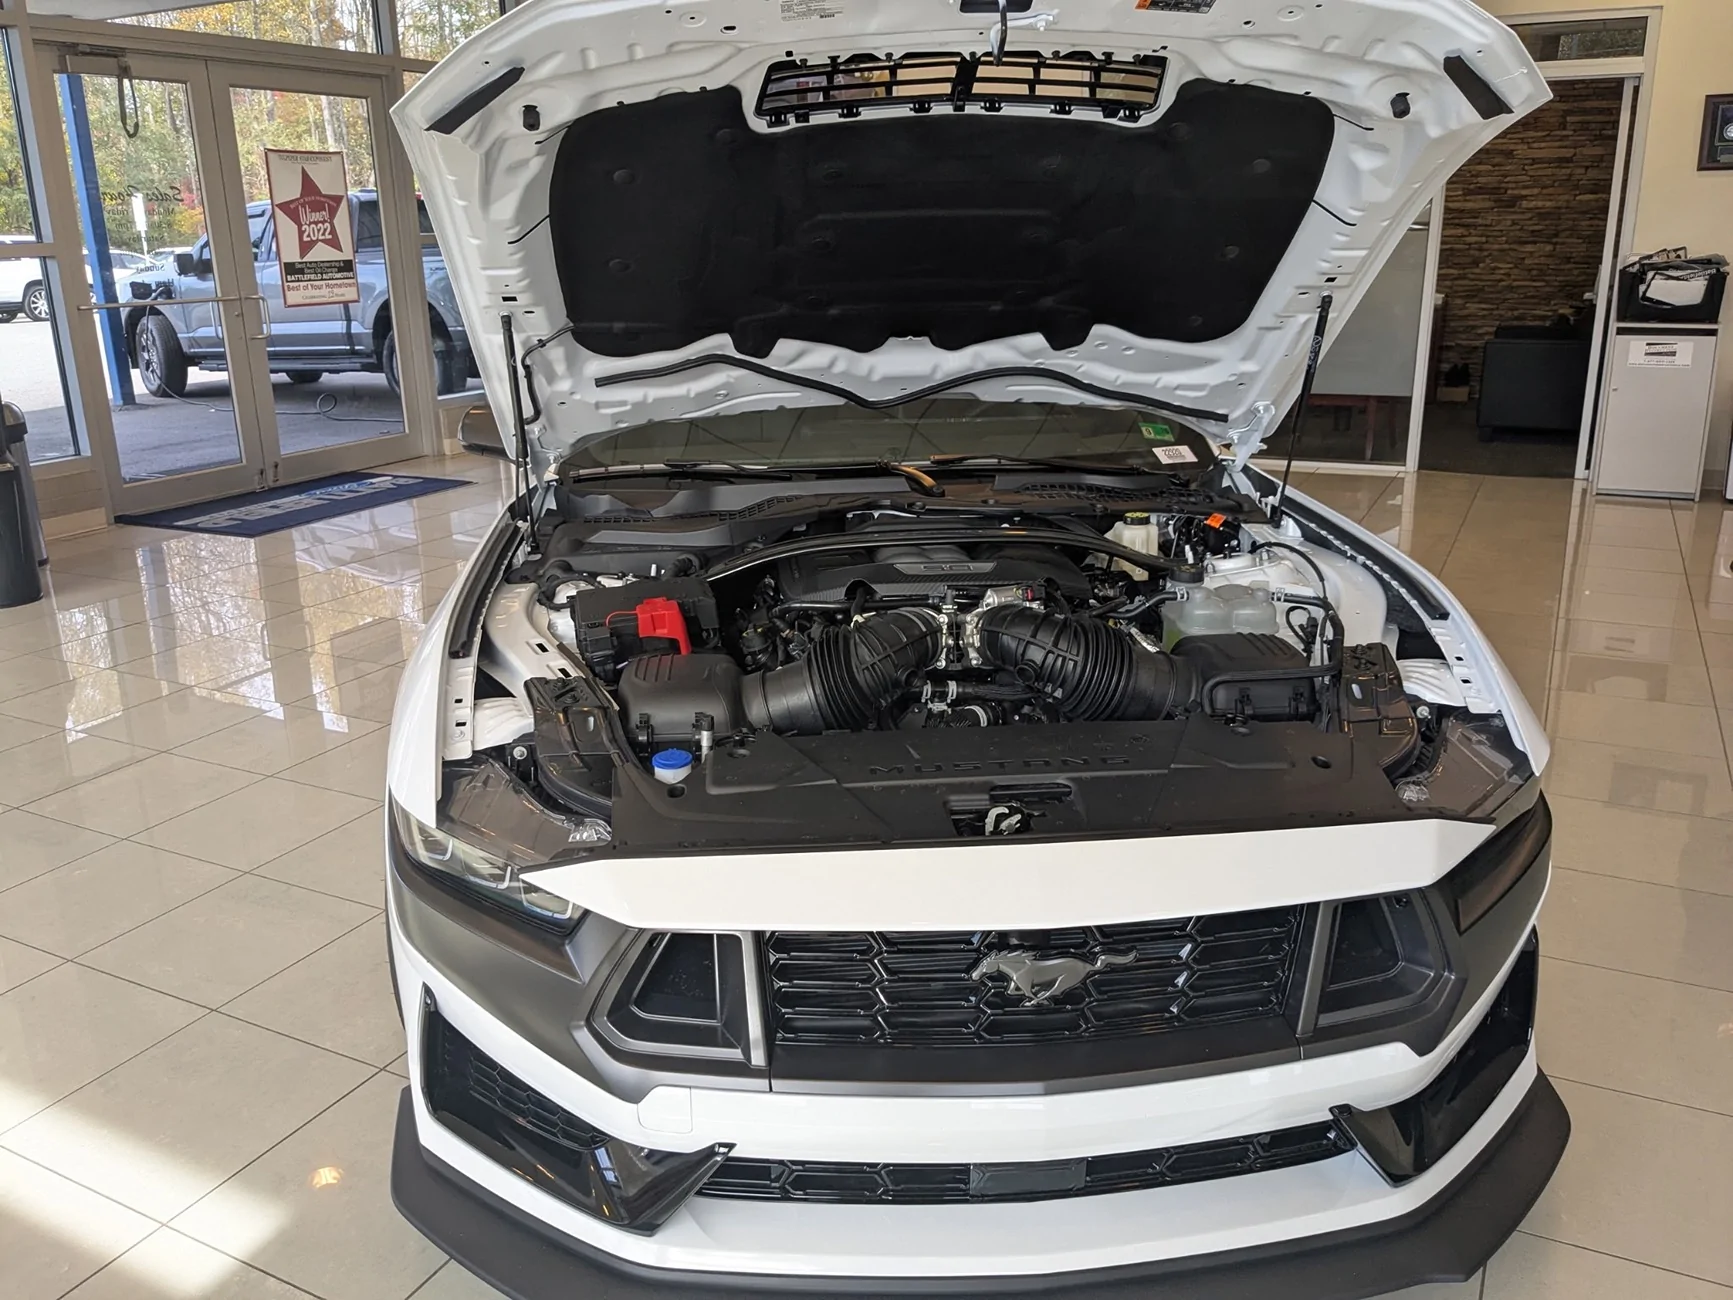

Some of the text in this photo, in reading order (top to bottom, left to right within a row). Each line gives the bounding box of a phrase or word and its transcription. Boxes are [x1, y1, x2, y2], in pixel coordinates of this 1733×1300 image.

[299, 203, 330, 225] Winner!
[302, 223, 333, 242] 2022
[322, 271, 355, 280] AUTOMOTIVE
[286, 284, 301, 292] Best
[310, 283, 324, 291] Your
[324, 281, 356, 289] Hometown
[868, 755, 1131, 776] MUSTANG
